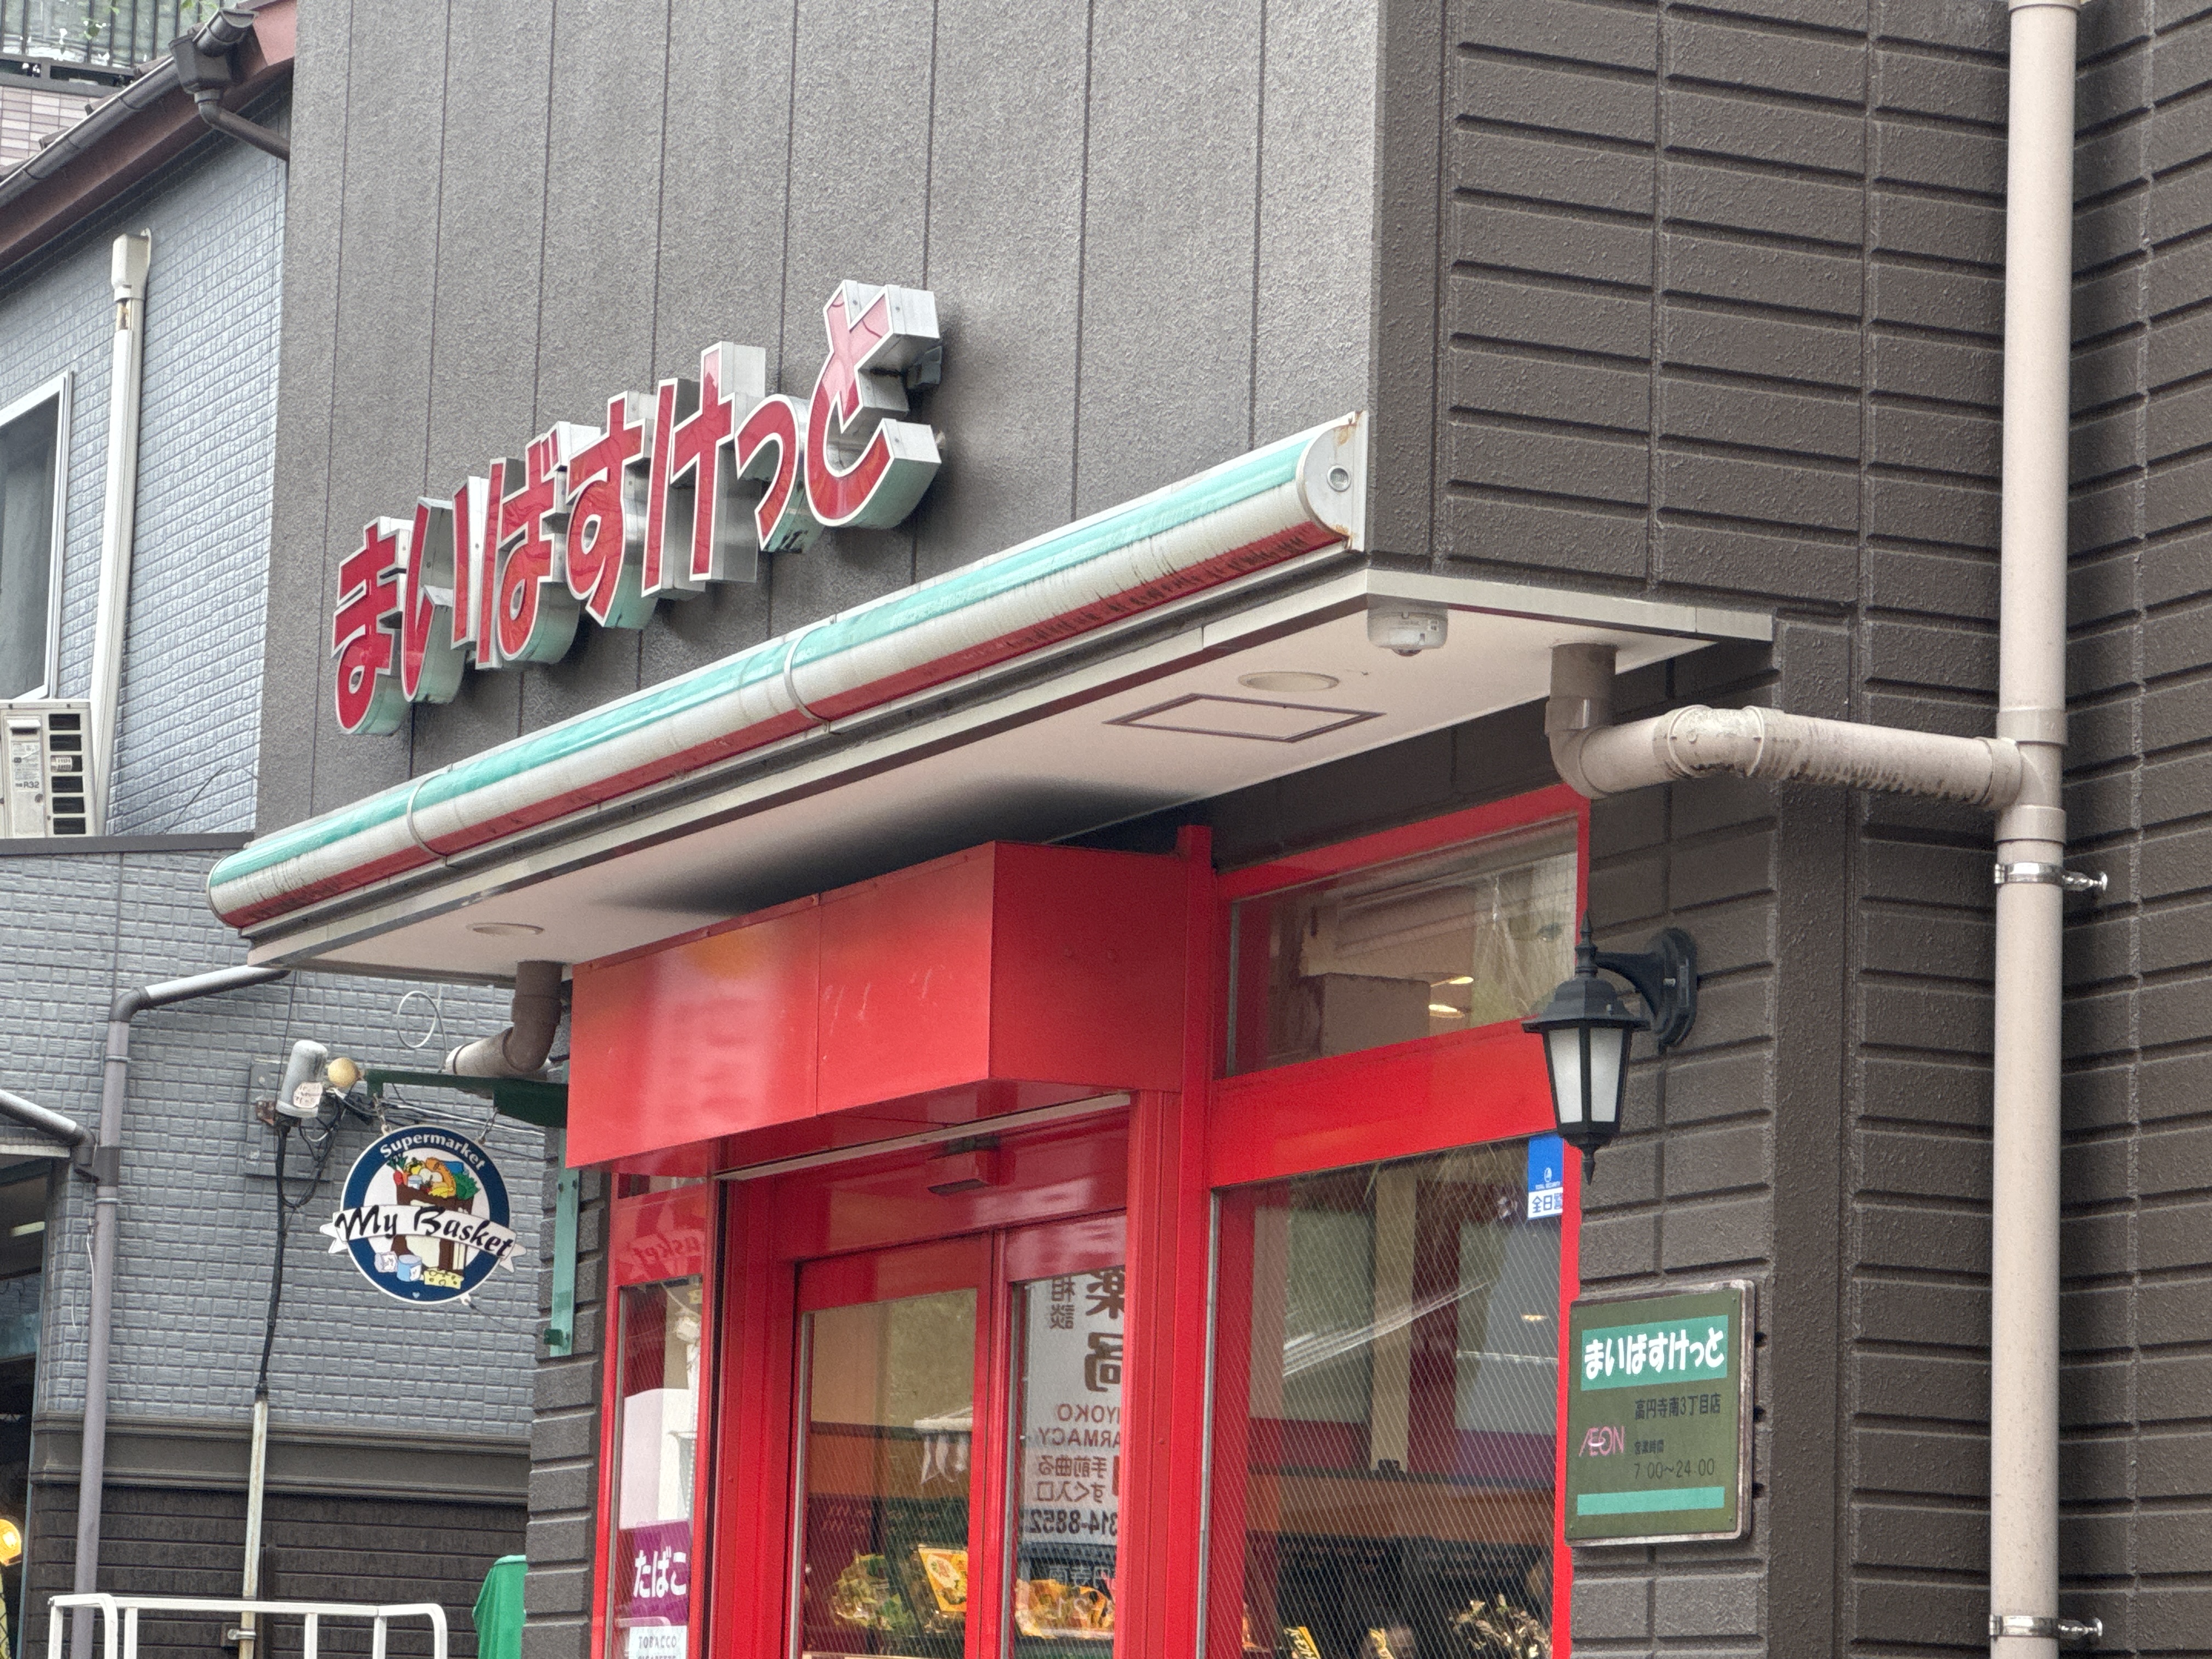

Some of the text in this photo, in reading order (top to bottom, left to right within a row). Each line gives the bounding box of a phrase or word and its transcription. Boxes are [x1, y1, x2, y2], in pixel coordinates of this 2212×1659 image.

[332, 280, 900, 734] まいばすけっと
[380, 1134, 485, 1171] Supermarket
[335, 1205, 514, 1257] My Basket
[1584, 1327, 1725, 1379] まいばすけっと
[1634, 1393, 1721, 1420] 高円寺南3丁目店
[633, 1545, 687, 1598] たばこ
[639, 1635, 677, 1649] TOBACCO
